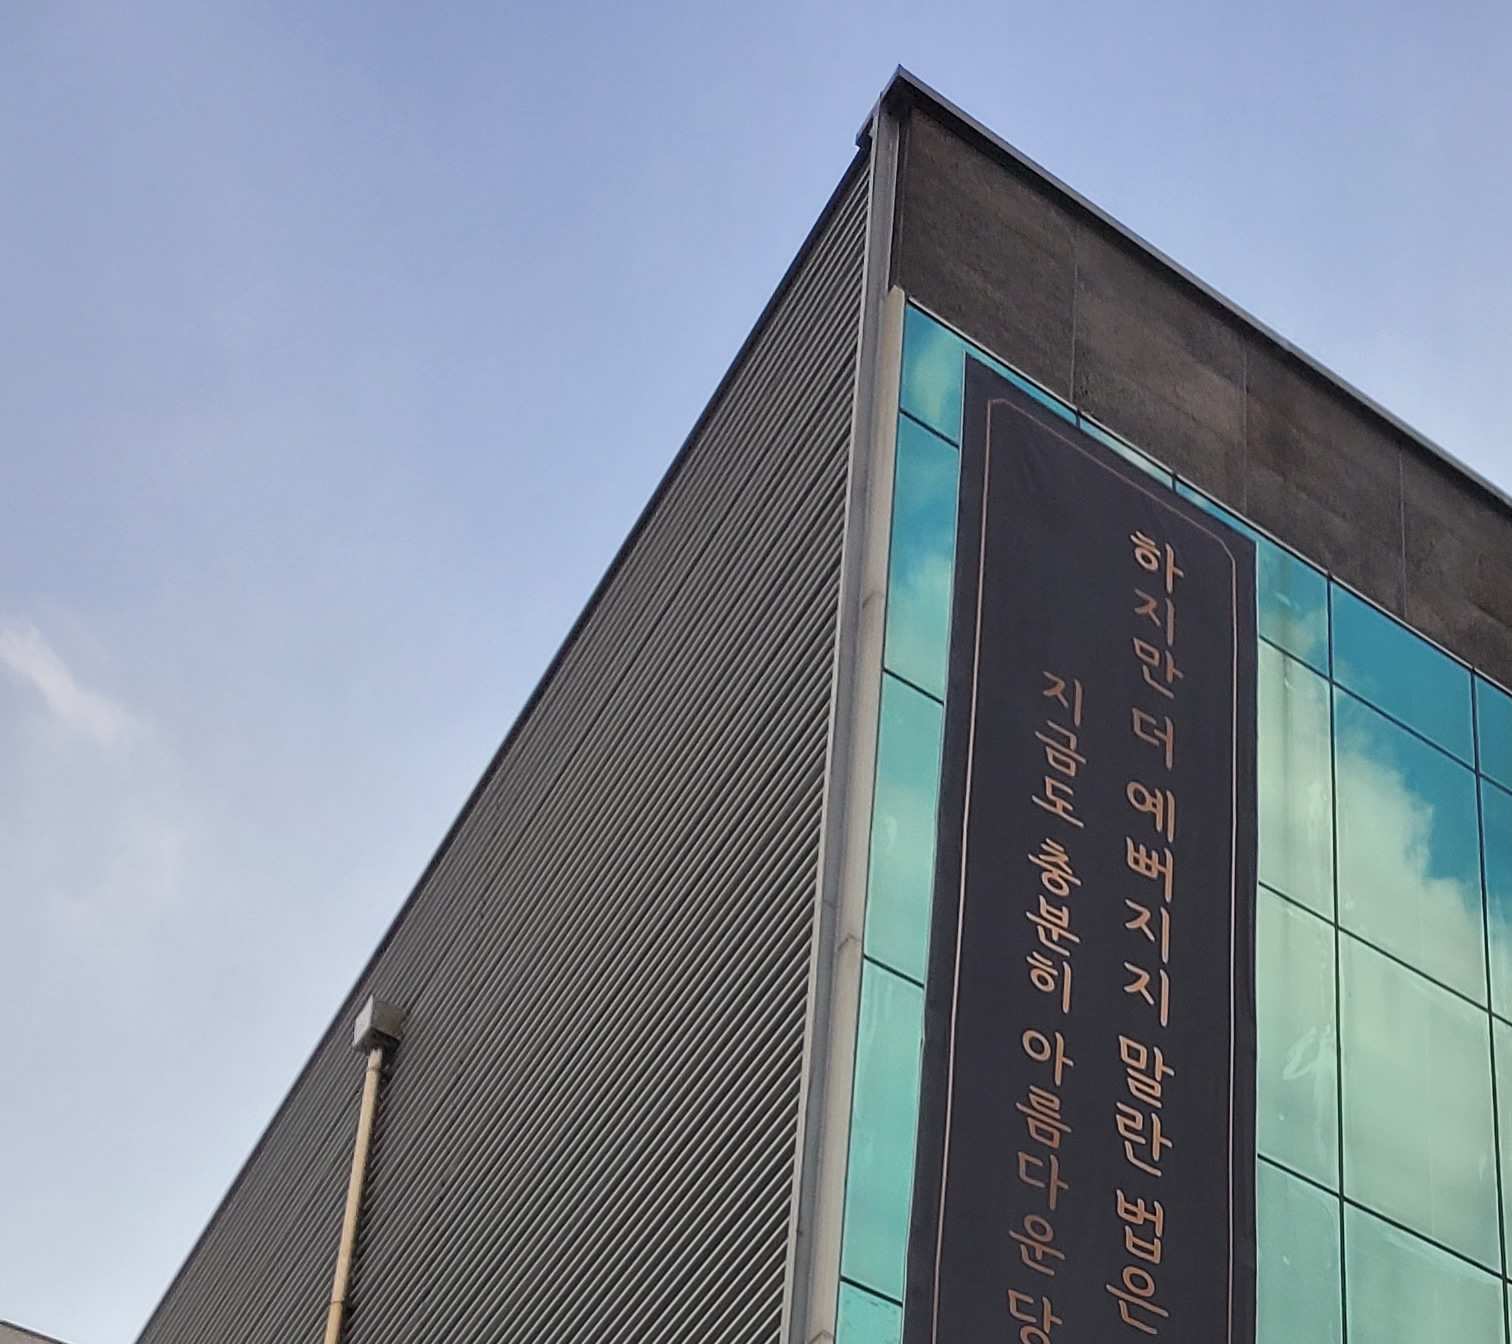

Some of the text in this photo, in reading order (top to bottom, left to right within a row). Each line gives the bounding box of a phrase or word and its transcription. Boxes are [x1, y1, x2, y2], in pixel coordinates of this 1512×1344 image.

[1130, 531, 1184, 699] 하지만
[1032, 671, 1086, 828] 지금도
[1133, 707, 1172, 770] 더
[1026, 838, 1081, 1014] 충분히
[1123, 780, 1176, 1027] 예뻐지지
[1009, 1029, 1074, 1276] 아름다운
[1116, 1034, 1174, 1176] 말란
[1106, 1187, 1169, 1335] 법은
